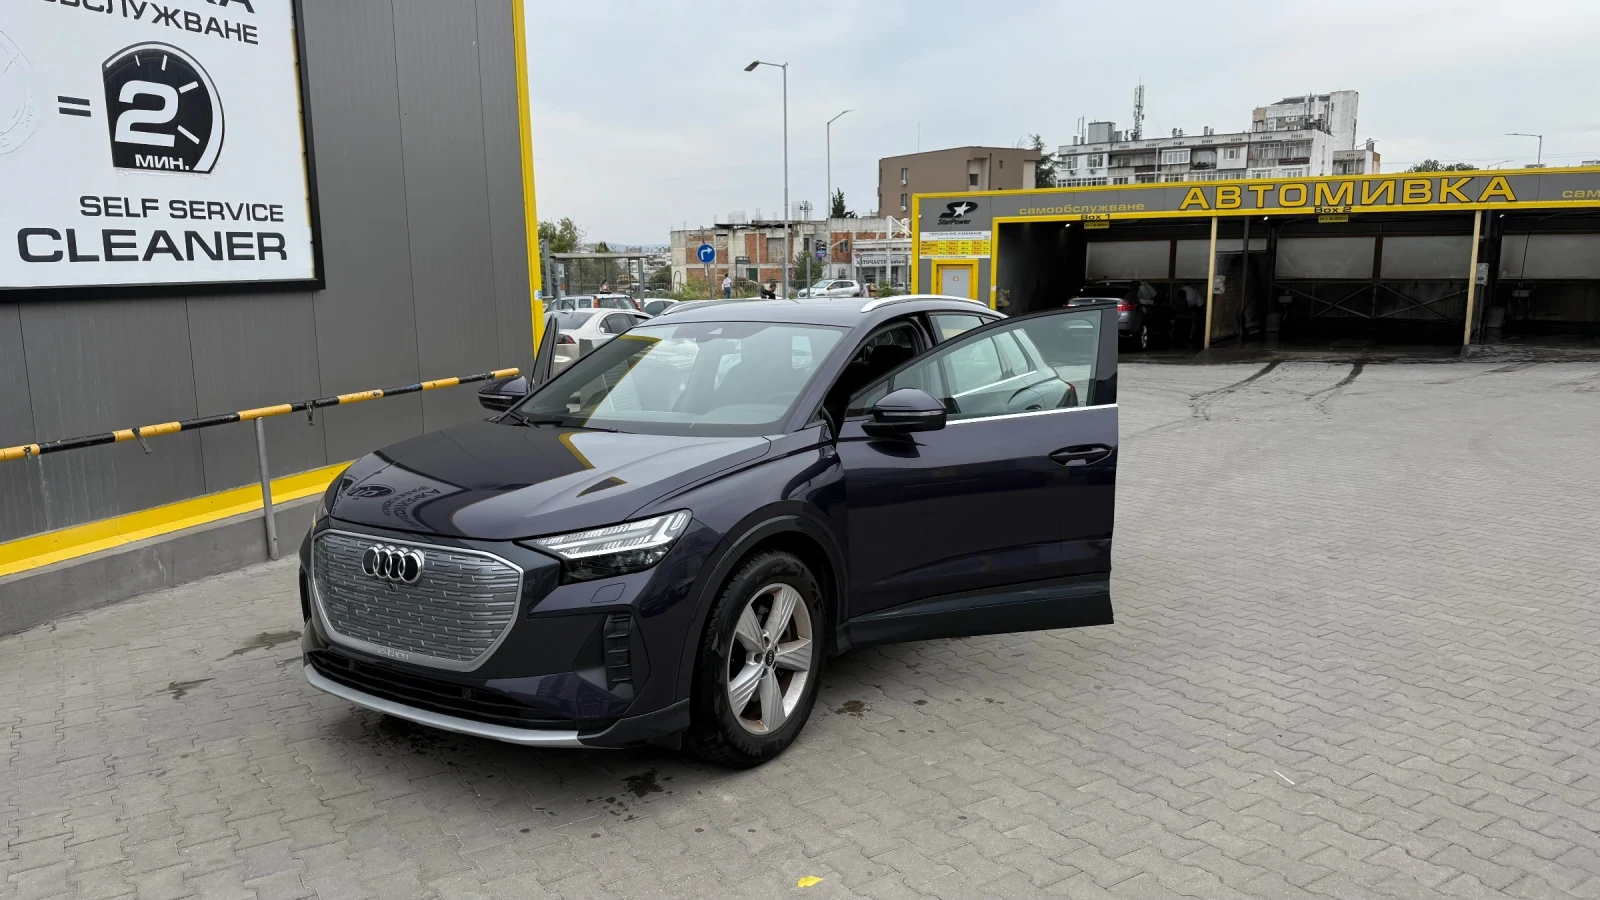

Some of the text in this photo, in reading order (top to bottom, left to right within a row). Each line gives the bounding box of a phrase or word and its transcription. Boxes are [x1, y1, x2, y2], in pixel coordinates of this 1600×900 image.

[135, 153, 190, 171] МИН.
[1178, 176, 1517, 210] АВТОМИВКА
[79, 195, 284, 222] SELF SERVICE
[1019, 203, 1145, 215] самообслужване
[1315, 206, 1338, 214] Box
[938, 218, 971, 226] StarPower
[17, 227, 288, 263] CLEANER
